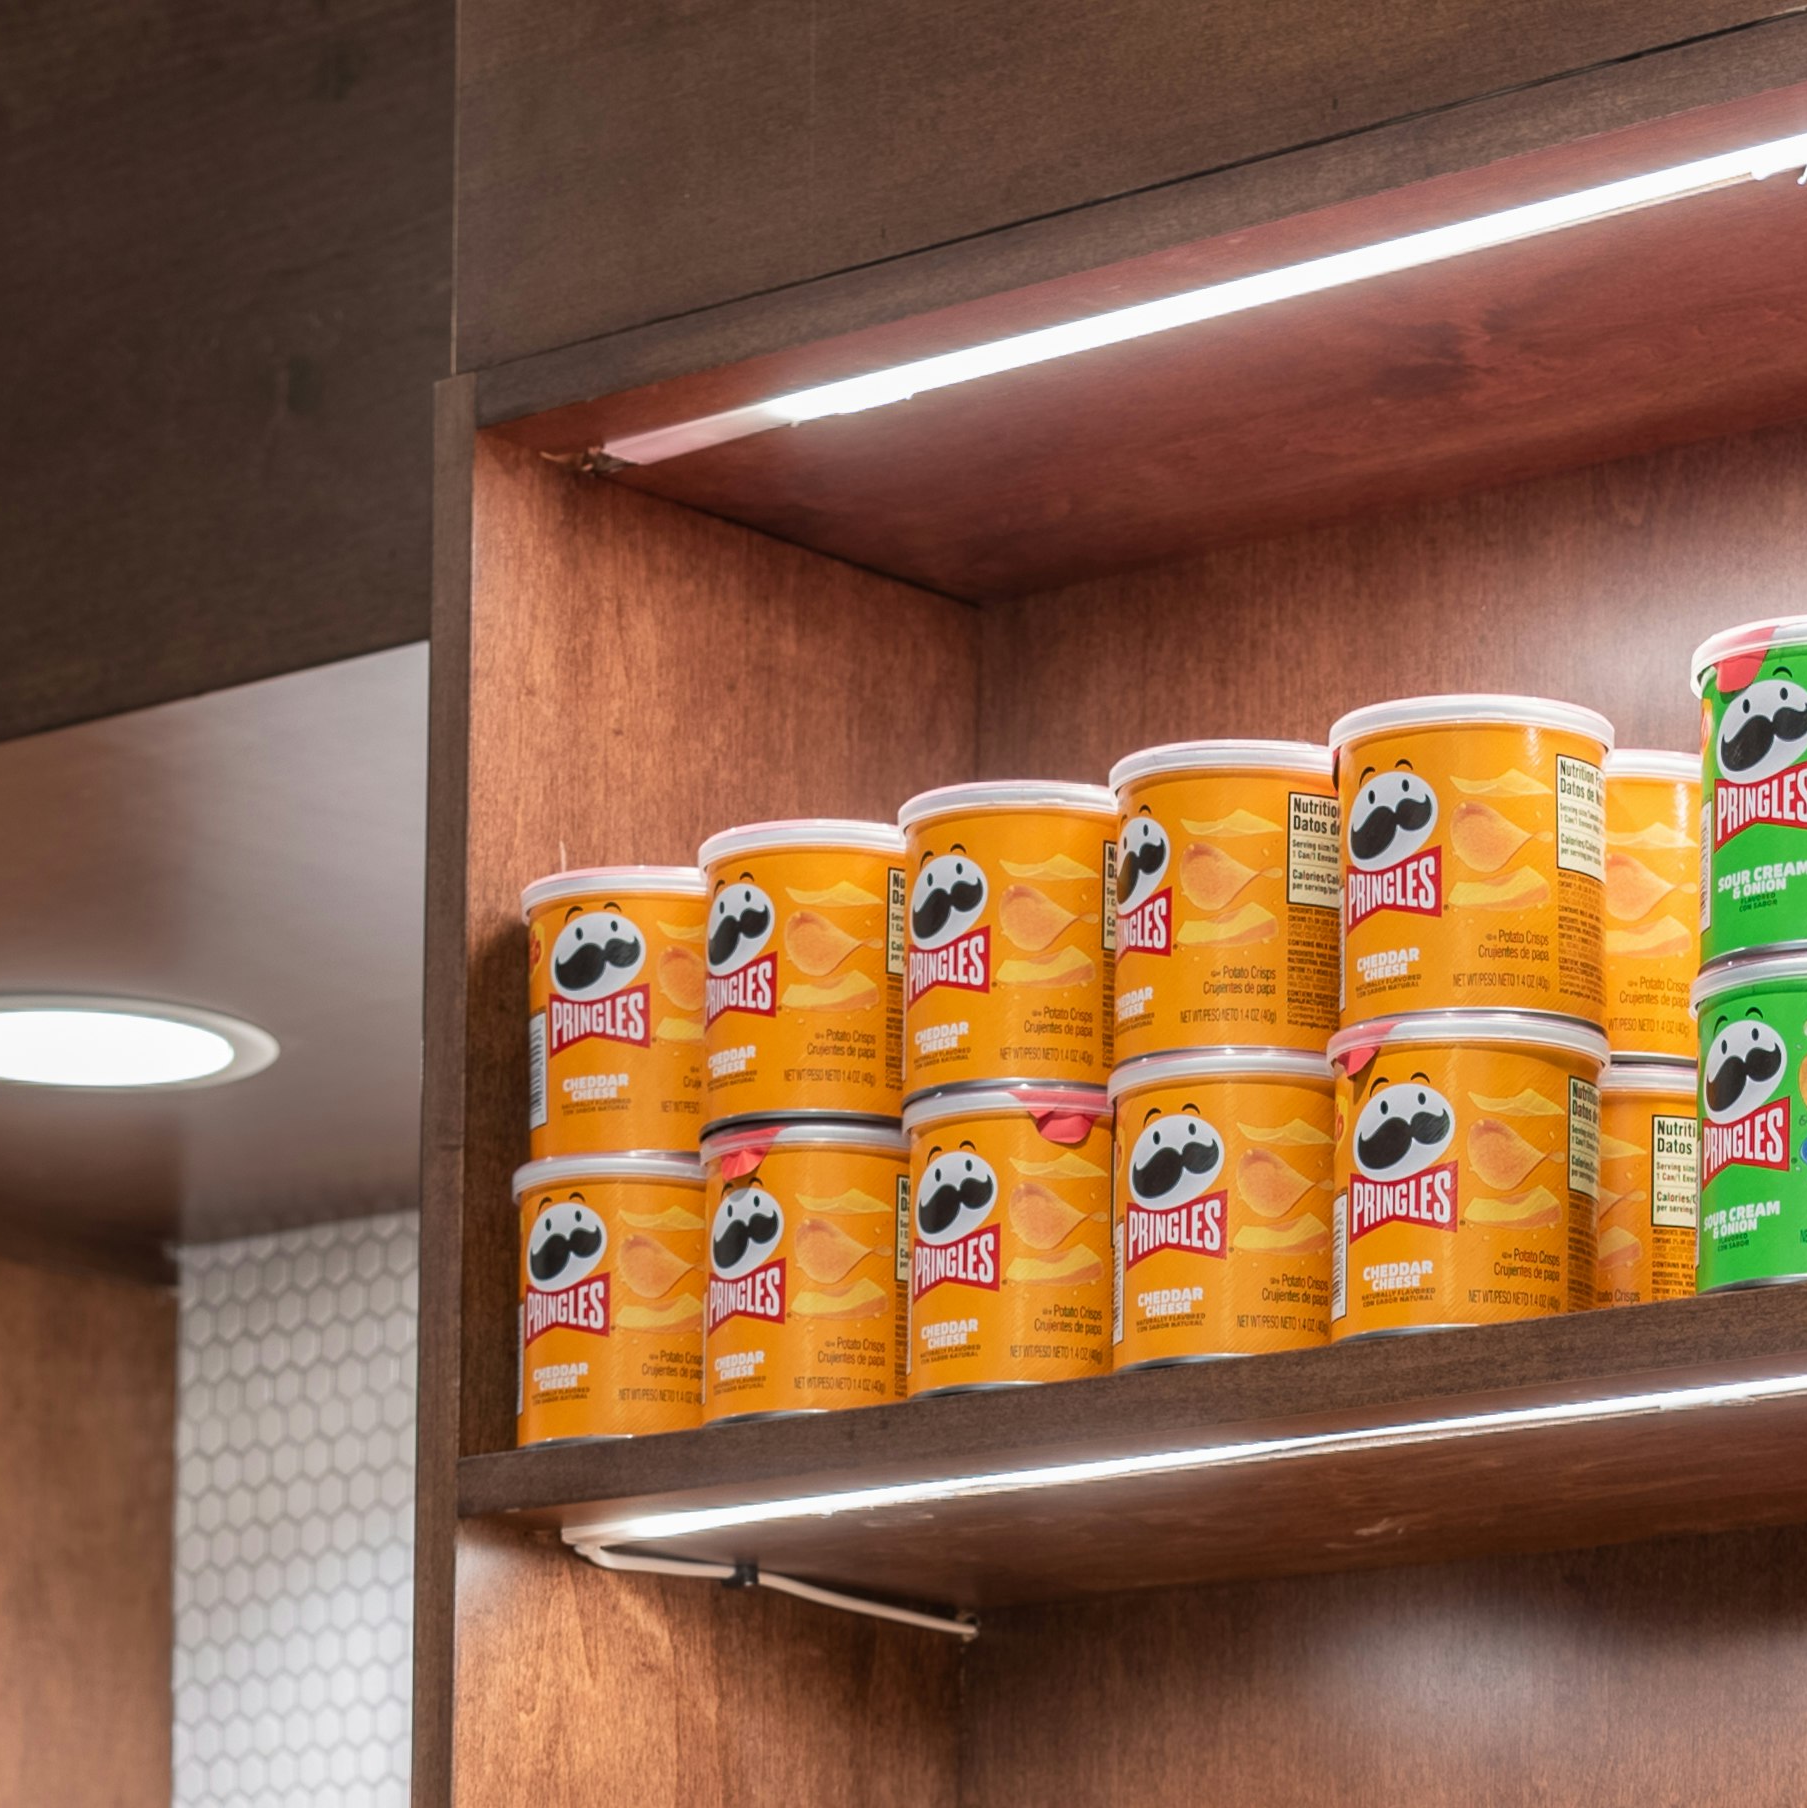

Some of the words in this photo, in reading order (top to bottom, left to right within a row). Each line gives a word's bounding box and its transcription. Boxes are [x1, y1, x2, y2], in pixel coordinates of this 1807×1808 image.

[1348, 856, 1436, 926] PRINGLES
[908, 935, 985, 1001] PRINGLES
[1356, 947, 1420, 970] CHEDDAR
[1364, 963, 1408, 980] CHEESE
[552, 993, 645, 1049] PRINGLES
[563, 1074, 629, 1092] CHEDDAR
[572, 1087, 617, 1102] CHEESE
[1704, 1107, 1783, 1180] PRINGLES
[1129, 1200, 1221, 1260] PRINGLES
[1352, 1169, 1451, 1235] PRINGLES
[913, 1232, 994, 1296] PRINGLES
[1363, 1260, 1433, 1280] CHEDDAR
[1371, 1274, 1420, 1291] CHEESE
[527, 1280, 605, 1339] PRINGLES
[709, 1268, 780, 1331] PRINGLES
